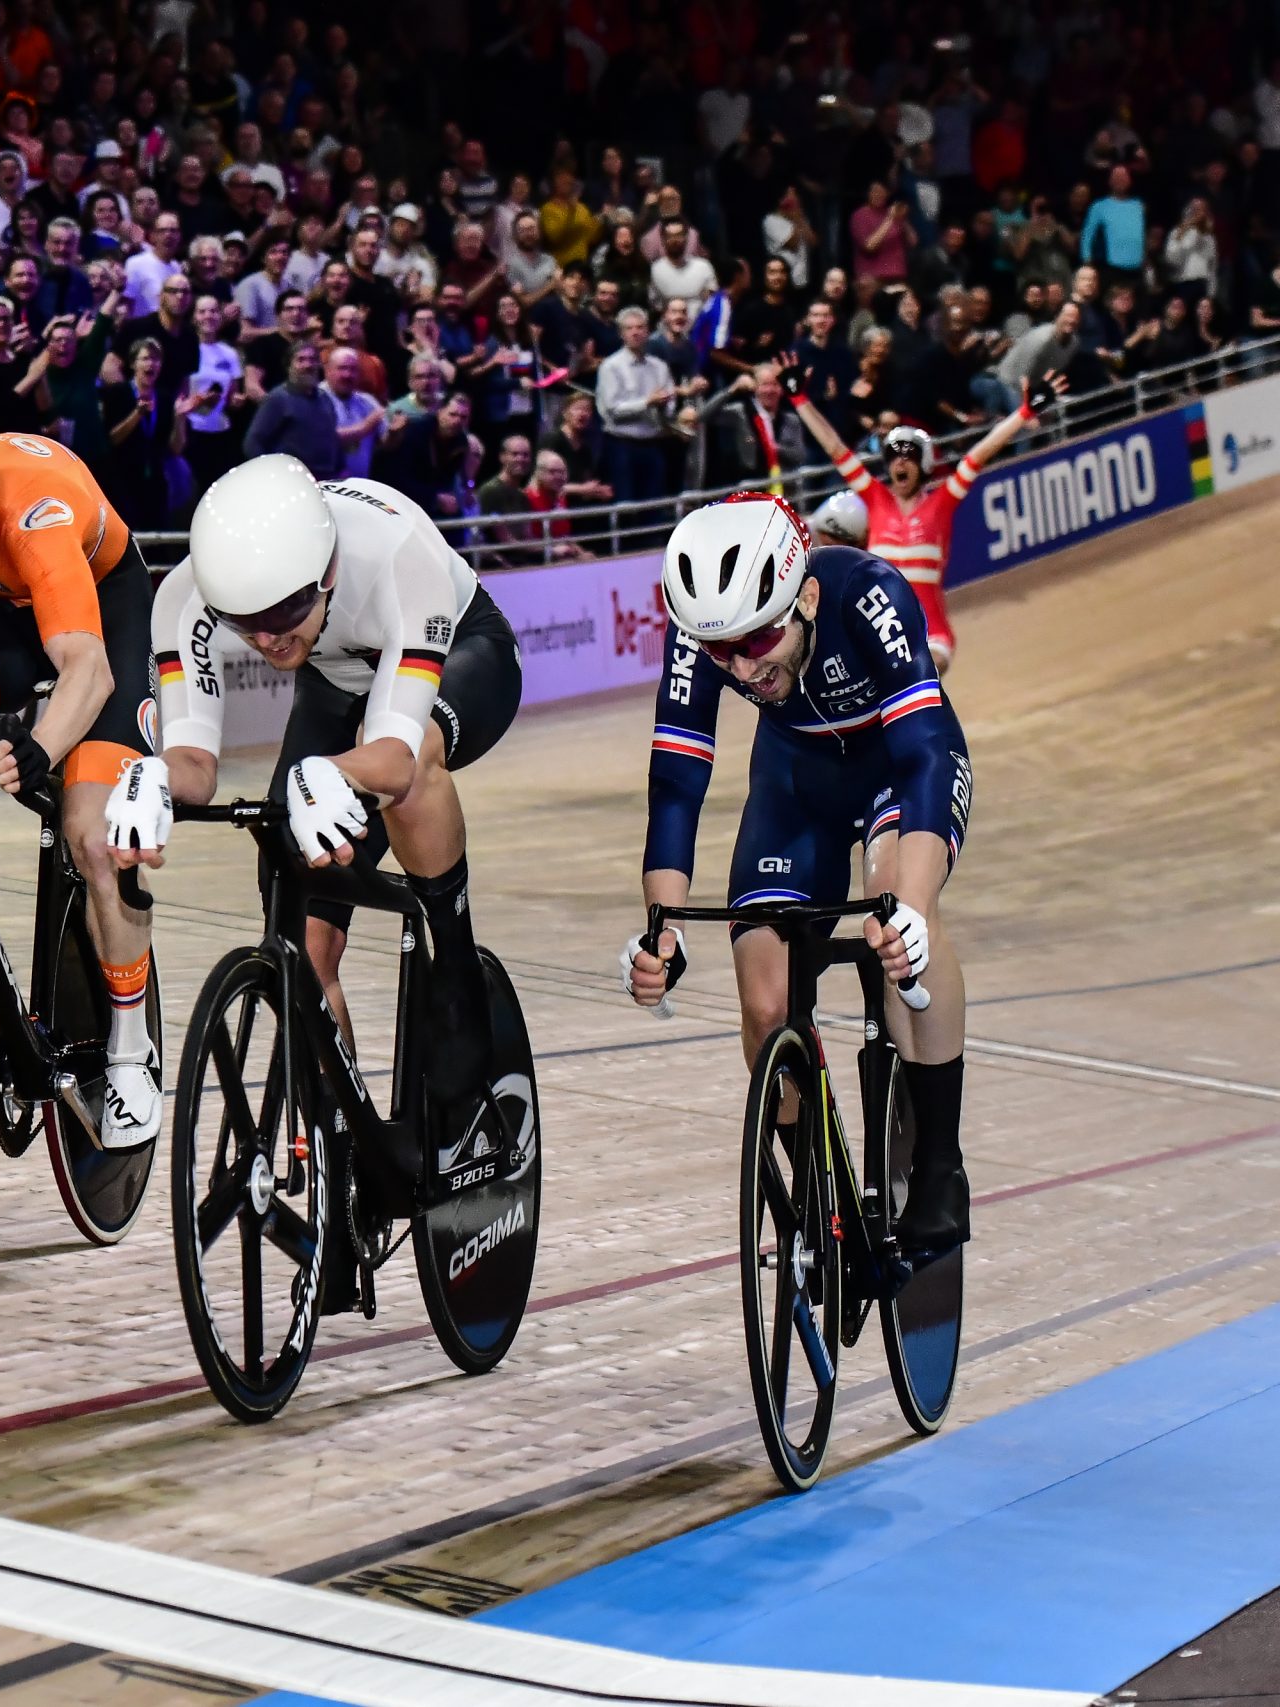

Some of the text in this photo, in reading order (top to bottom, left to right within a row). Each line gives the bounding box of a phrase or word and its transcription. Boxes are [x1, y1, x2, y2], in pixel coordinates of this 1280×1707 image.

[982, 433, 1157, 560] SHIMANO
[191, 605, 220, 698] ŠKODA
[698, 620, 723, 630] GIRO
[855, 584, 913, 664] SKF
[669, 629, 700, 706] SKF
[820, 677, 870, 698] LOOK
[234, 807, 261, 816] FES
[106, 1081, 143, 1128] ONT
[449, 1200, 526, 1281] CORIMA
